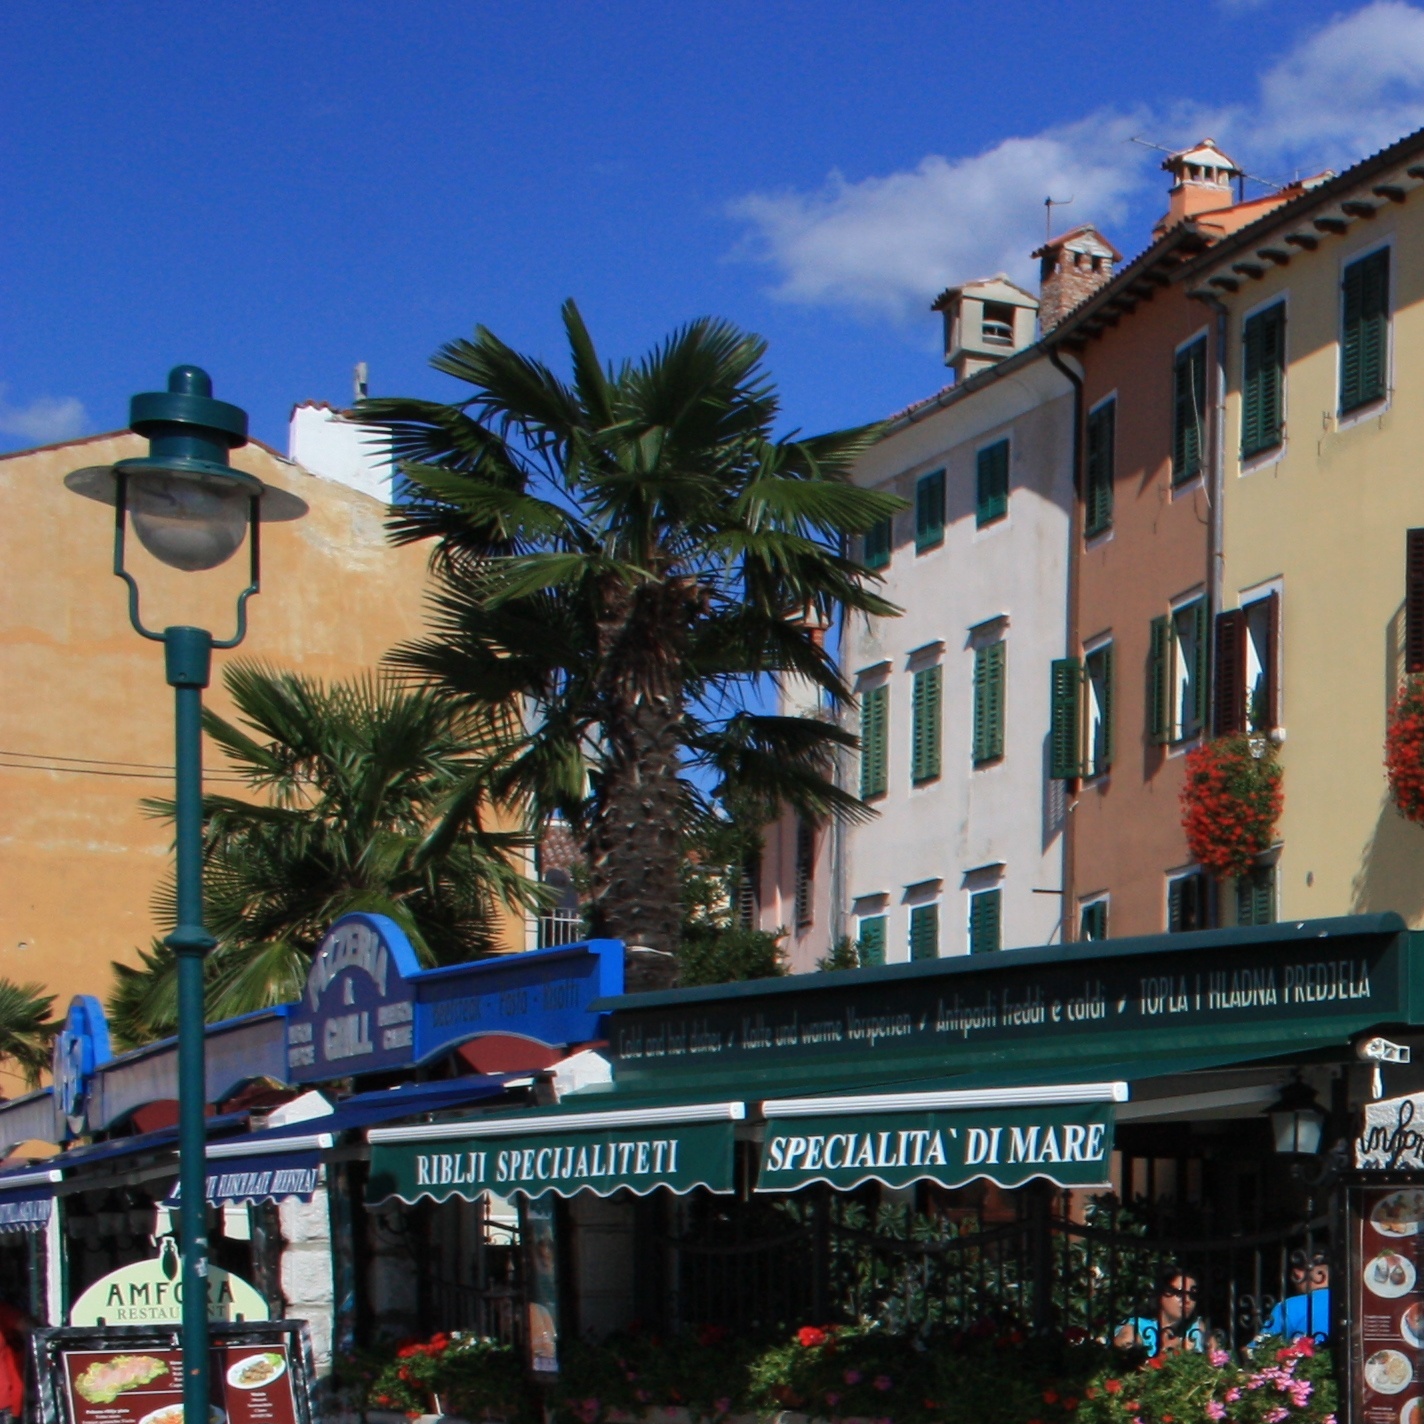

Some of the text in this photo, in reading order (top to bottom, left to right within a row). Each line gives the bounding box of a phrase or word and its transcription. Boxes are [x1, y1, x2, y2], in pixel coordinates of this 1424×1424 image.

[1140, 959, 1371, 1015] TOPLA I HLADNA PREDJELA
[324, 1010, 374, 1062] GRILL
[776, 1011, 798, 1046] und
[801, 1018, 844, 1044] warme
[936, 990, 996, 1038] Antipasti
[1002, 987, 1045, 1026] freddi
[1051, 1002, 1061, 1023] e
[1067, 980, 1106, 1021] caldi
[417, 1139, 680, 1186] RIBLJI SPECIJALITETI
[964, 1127, 1000, 1165] DI
[1007, 1123, 1106, 1164] MARE
[106, 1281, 236, 1307] AMFA
[117, 1306, 226, 1321] RESTAUNT
